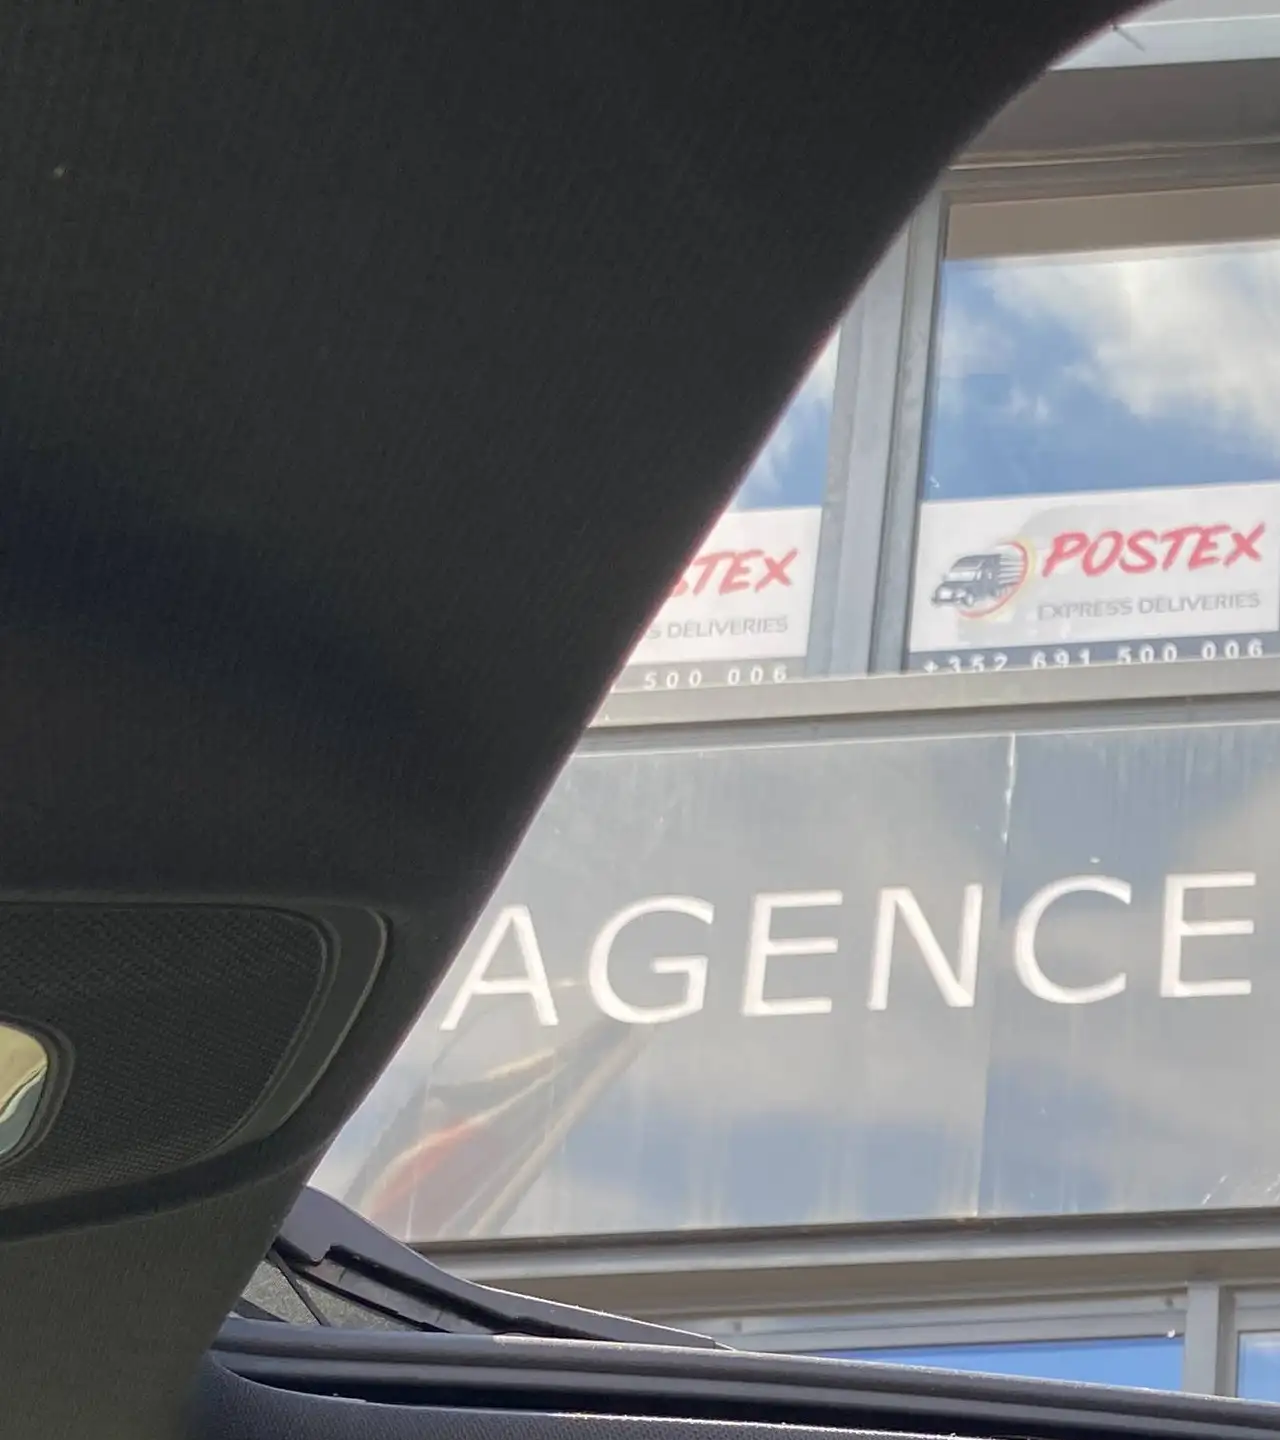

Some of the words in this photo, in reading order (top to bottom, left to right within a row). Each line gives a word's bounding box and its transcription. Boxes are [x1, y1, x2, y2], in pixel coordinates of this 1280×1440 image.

[1041, 522, 1266, 578] POSTEX
[1037, 601, 1133, 622] EXPRESS
[1139, 591, 1262, 616] DELIVERIES
[667, 614, 789, 639] DELIVERIES
[924, 654, 1008, 673] +352
[1032, 648, 1092, 669] 691
[1116, 641, 1178, 665] 500
[1202, 638, 1264, 660] 006
[643, 667, 704, 690] 500
[728, 663, 788, 686] 006
[438, 872, 1257, 1031] AGENCE
